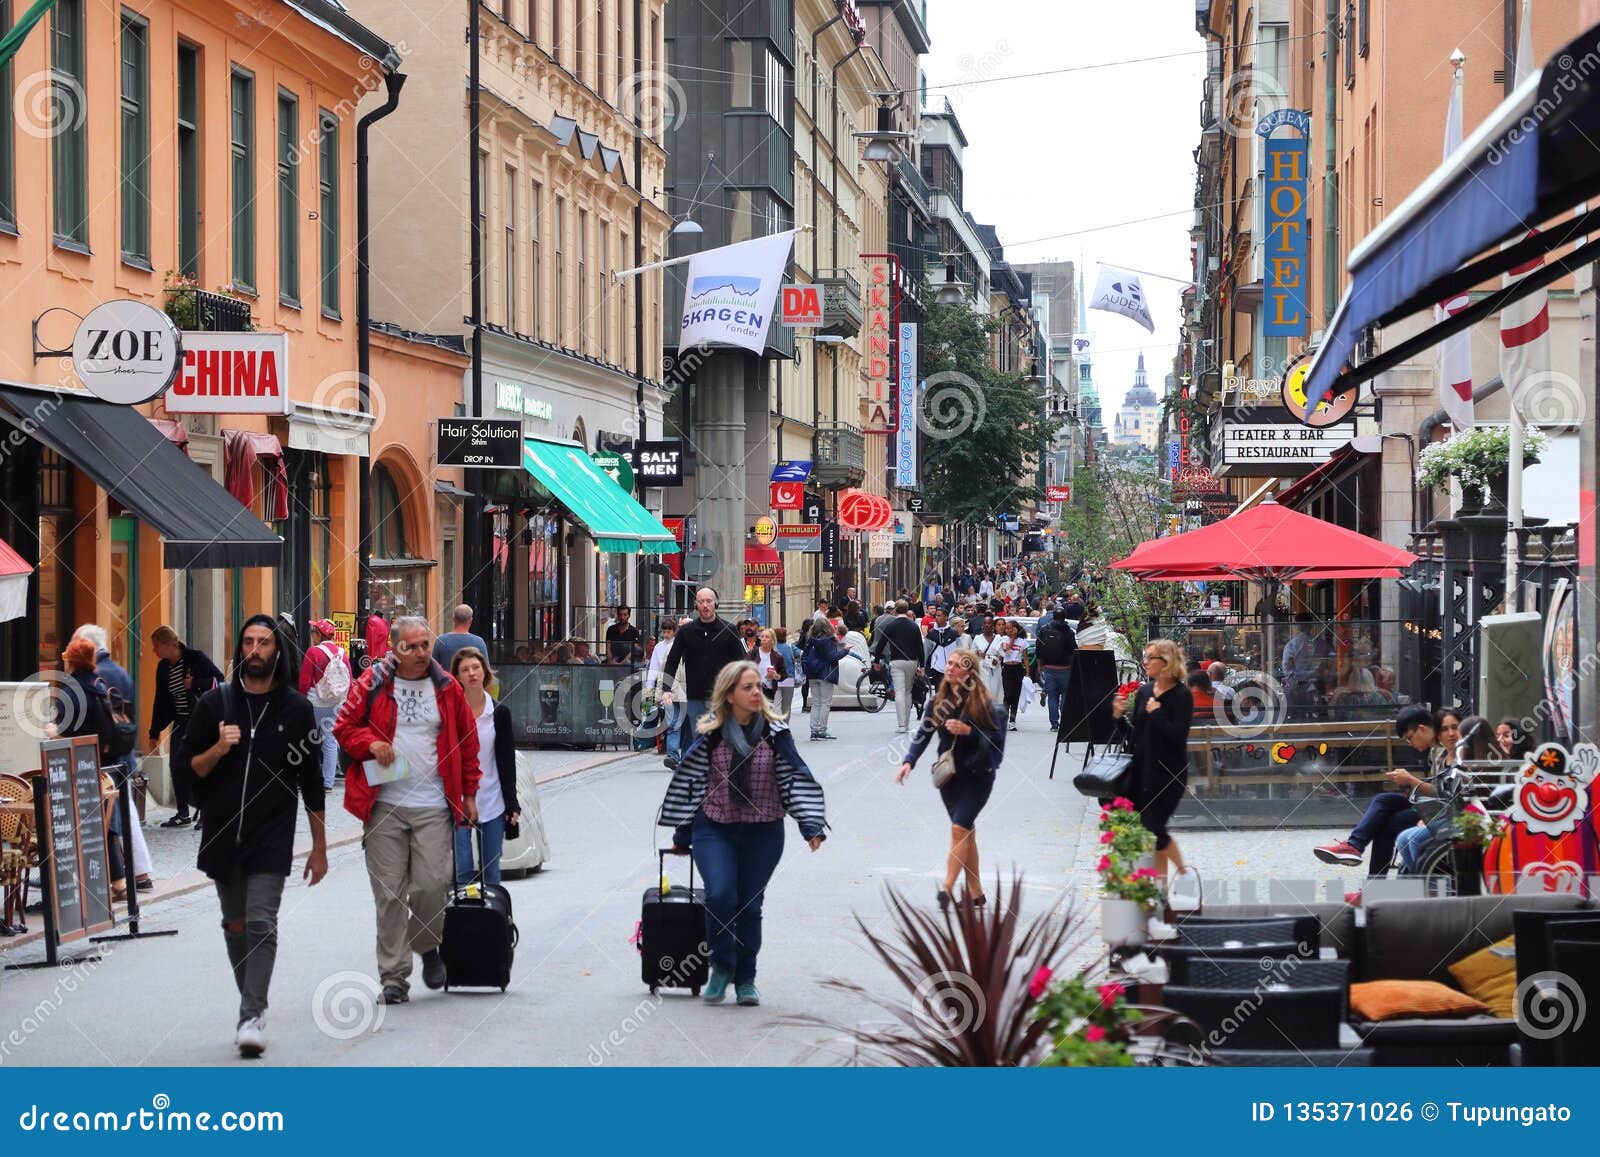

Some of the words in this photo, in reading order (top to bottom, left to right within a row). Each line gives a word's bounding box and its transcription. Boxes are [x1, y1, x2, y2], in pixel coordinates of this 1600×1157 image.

[1269, 151, 1303, 325] HOTEL
[783, 288, 820, 315] DA
[682, 308, 763, 329] SKAGEN
[87, 329, 163, 361] ZOE
[870, 264, 888, 423] SKANDIA
[173, 351, 279, 396] CHINA
[900, 325, 912, 485] SIDENCARLSON
[441, 424, 468, 437] Hair
[471, 424, 519, 438] Solution
[1233, 430, 1276, 440] TEATER
[1283, 430, 1291, 440] &
[1300, 430, 1324, 440] BAR
[641, 452, 679, 463] SALT
[1238, 447, 1316, 458] RESTAURANT
[643, 464, 677, 475] MEN
[526, 726, 557, 734] Guinness
